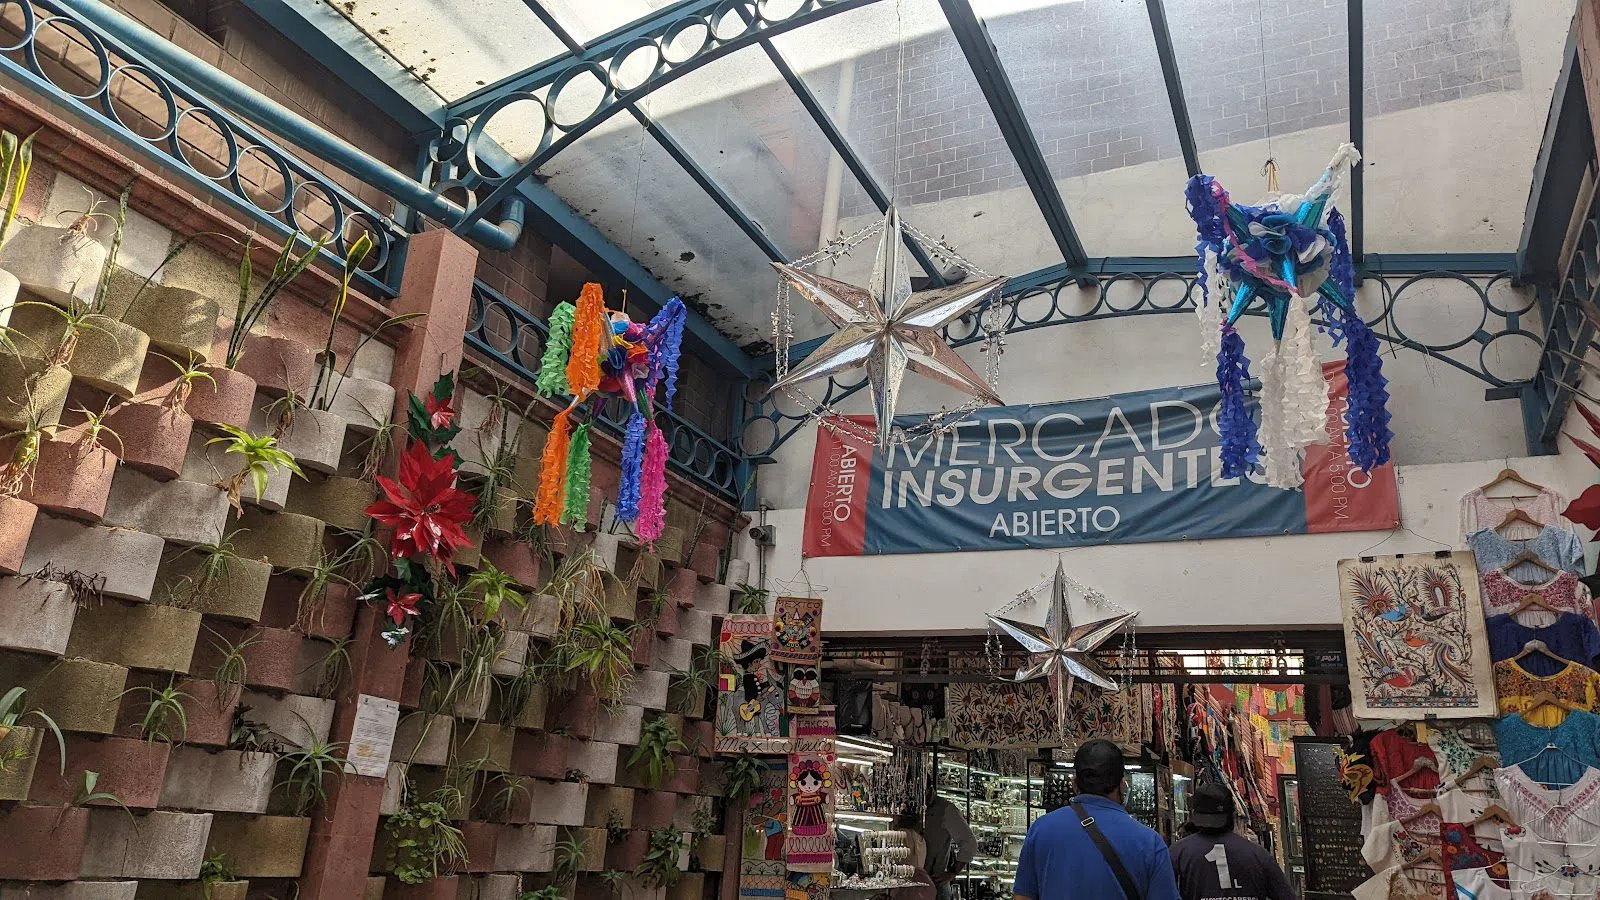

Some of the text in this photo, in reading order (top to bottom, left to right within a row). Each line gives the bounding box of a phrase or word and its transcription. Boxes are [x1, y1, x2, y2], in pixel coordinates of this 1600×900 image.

[886, 400, 1223, 468] MERCAD
[1328, 450, 1342, 462] A
[826, 469, 838, 487] AM
[833, 444, 858, 522] ABIERTO
[1329, 465, 1347, 493] 5:00
[825, 491, 835, 500] A
[822, 501, 834, 525] 5:00
[1332, 497, 1349, 520] PM
[989, 505, 1121, 538] ABIERTO
[820, 528, 832, 547] PM
